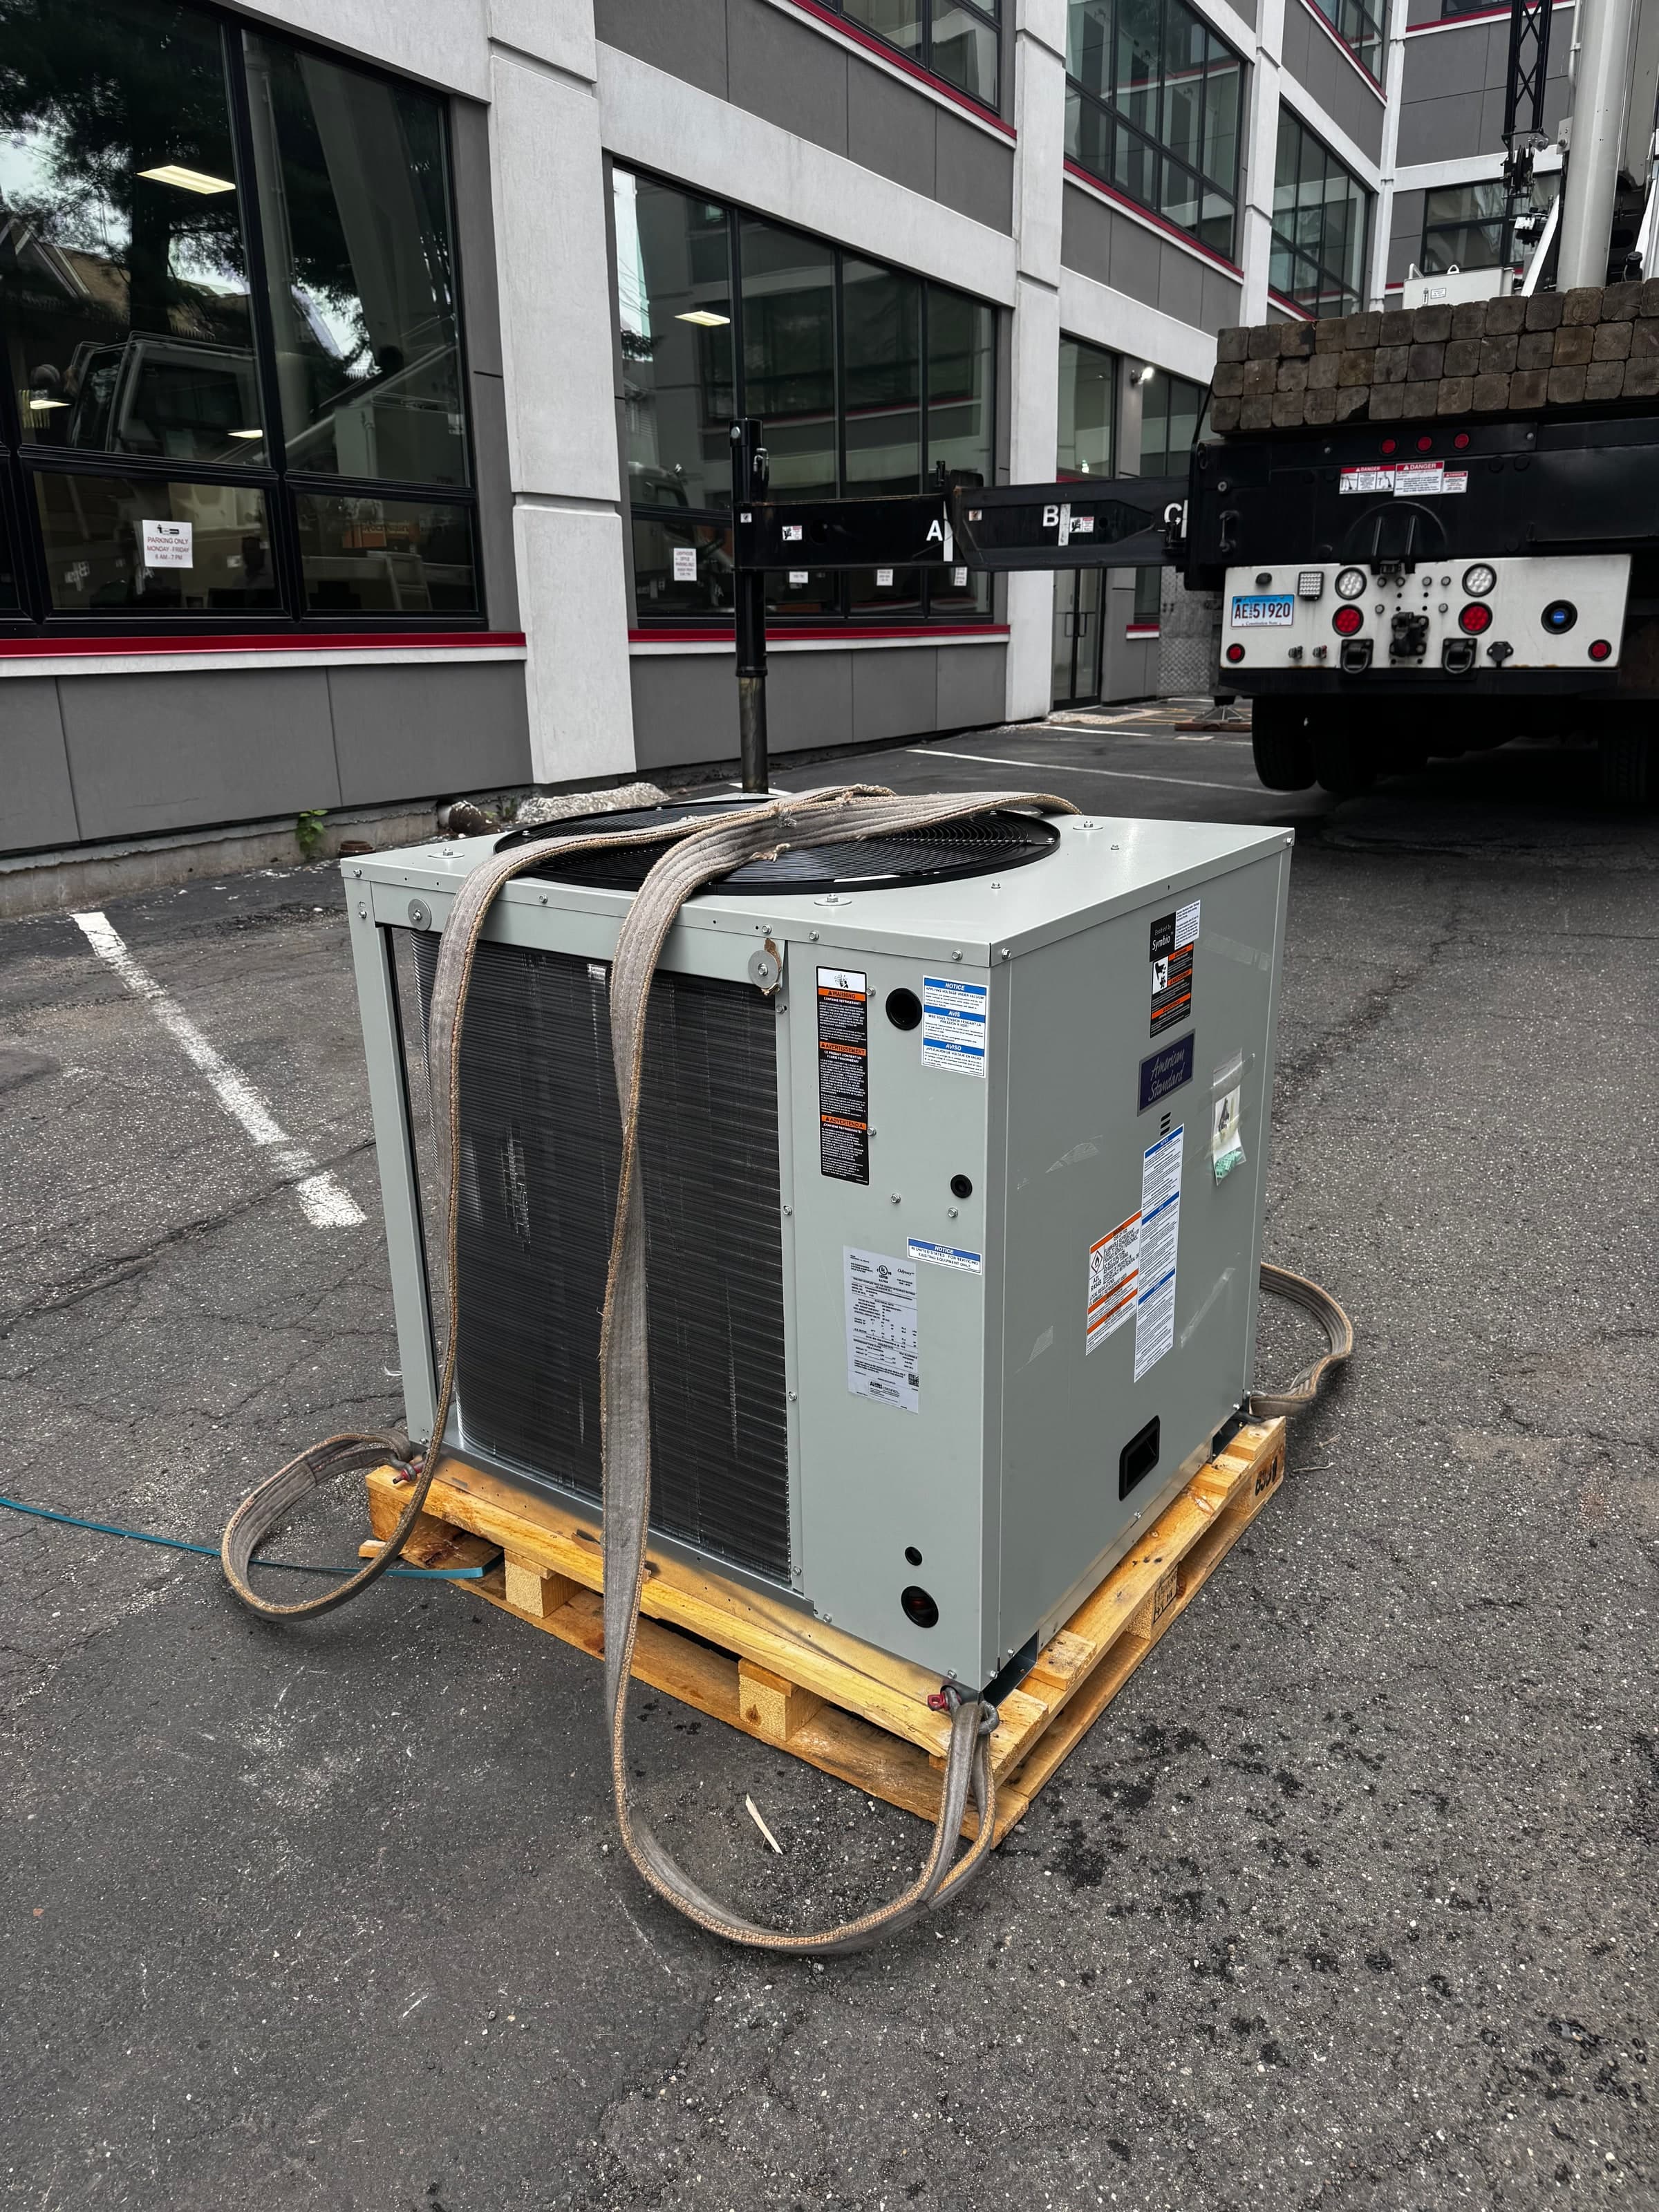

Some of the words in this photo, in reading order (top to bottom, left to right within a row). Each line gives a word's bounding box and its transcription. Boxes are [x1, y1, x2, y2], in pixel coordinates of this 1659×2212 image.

[1042, 505, 1058, 527] B
[1164, 503, 1182, 525] C
[926, 520, 943, 541] A
[945, 982, 966, 991] NOTICE
[833, 991, 856, 999] WARNING
[825, 1043, 865, 1055] AVERTISSEMENT
[1150, 1048, 1185, 1081] American
[1147, 1062, 1185, 1102] Standard
[830, 1117, 863, 1128] ADVERTENCIA
[934, 1246, 954, 1255] NOTICE
[937, 1257, 959, 1266] EQUIPMENT
